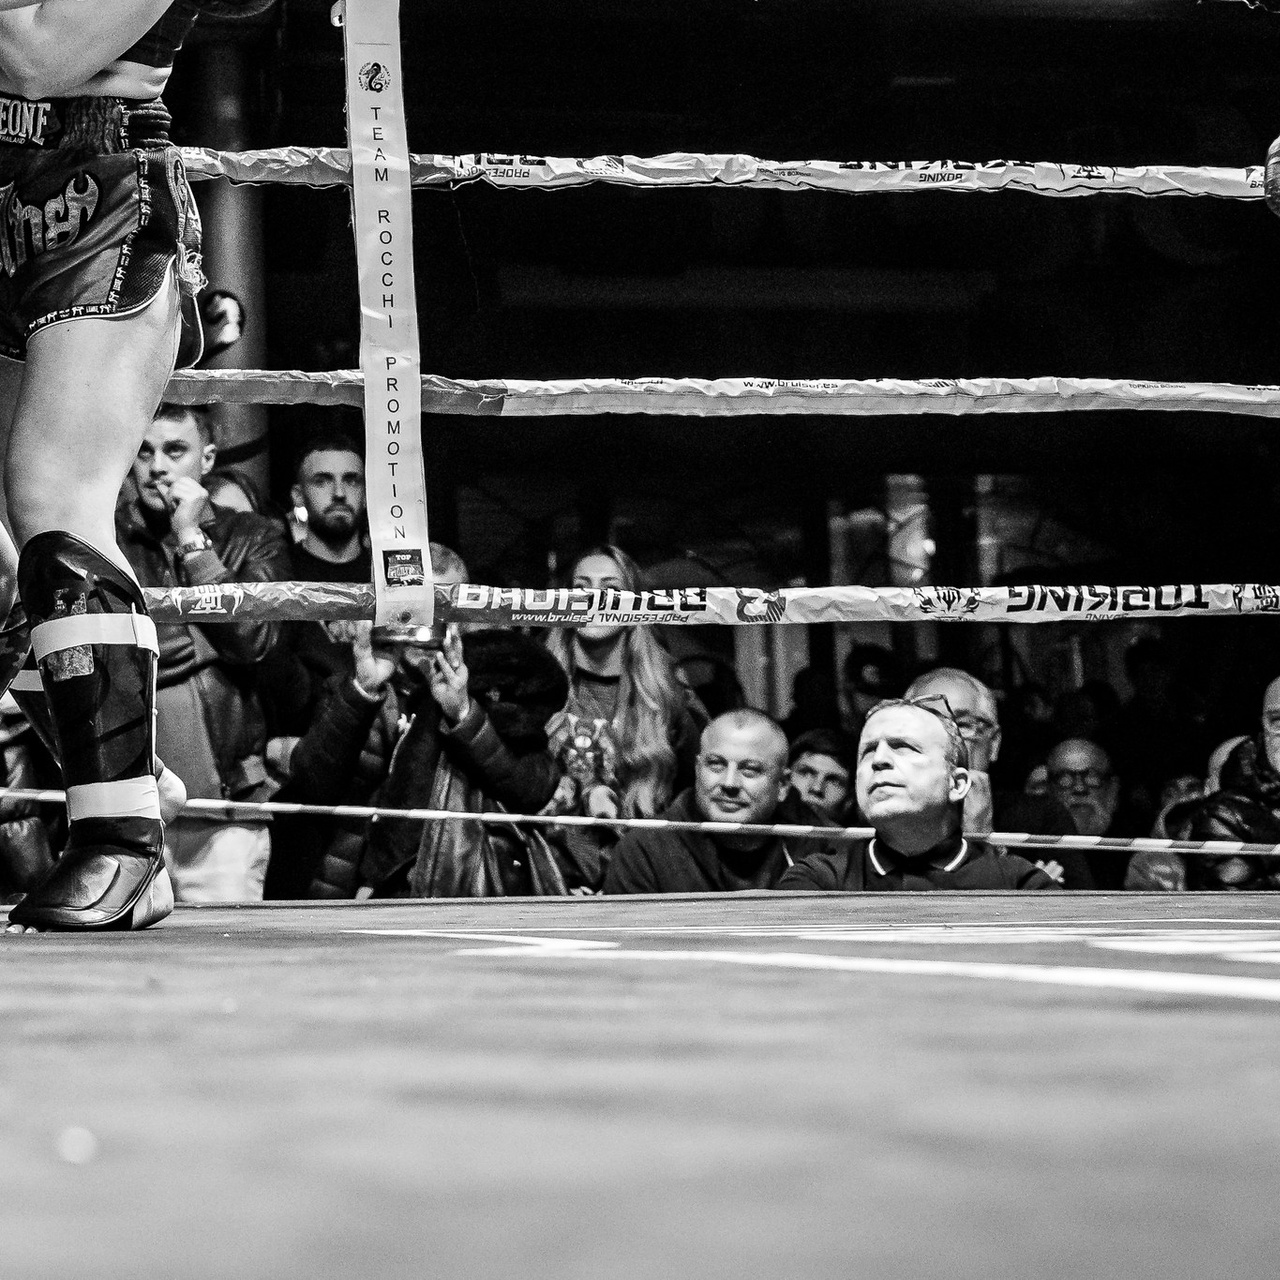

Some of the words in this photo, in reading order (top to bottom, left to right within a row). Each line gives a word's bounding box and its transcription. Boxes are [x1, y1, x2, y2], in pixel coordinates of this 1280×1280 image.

[370, 106, 389, 182] TEAM
[918, 172, 964, 183] BOXING
[378, 210, 394, 329] ROCCHI
[385, 356, 406, 539] PROMOTION
[598, 612, 690, 624] PROFESSIONAL
